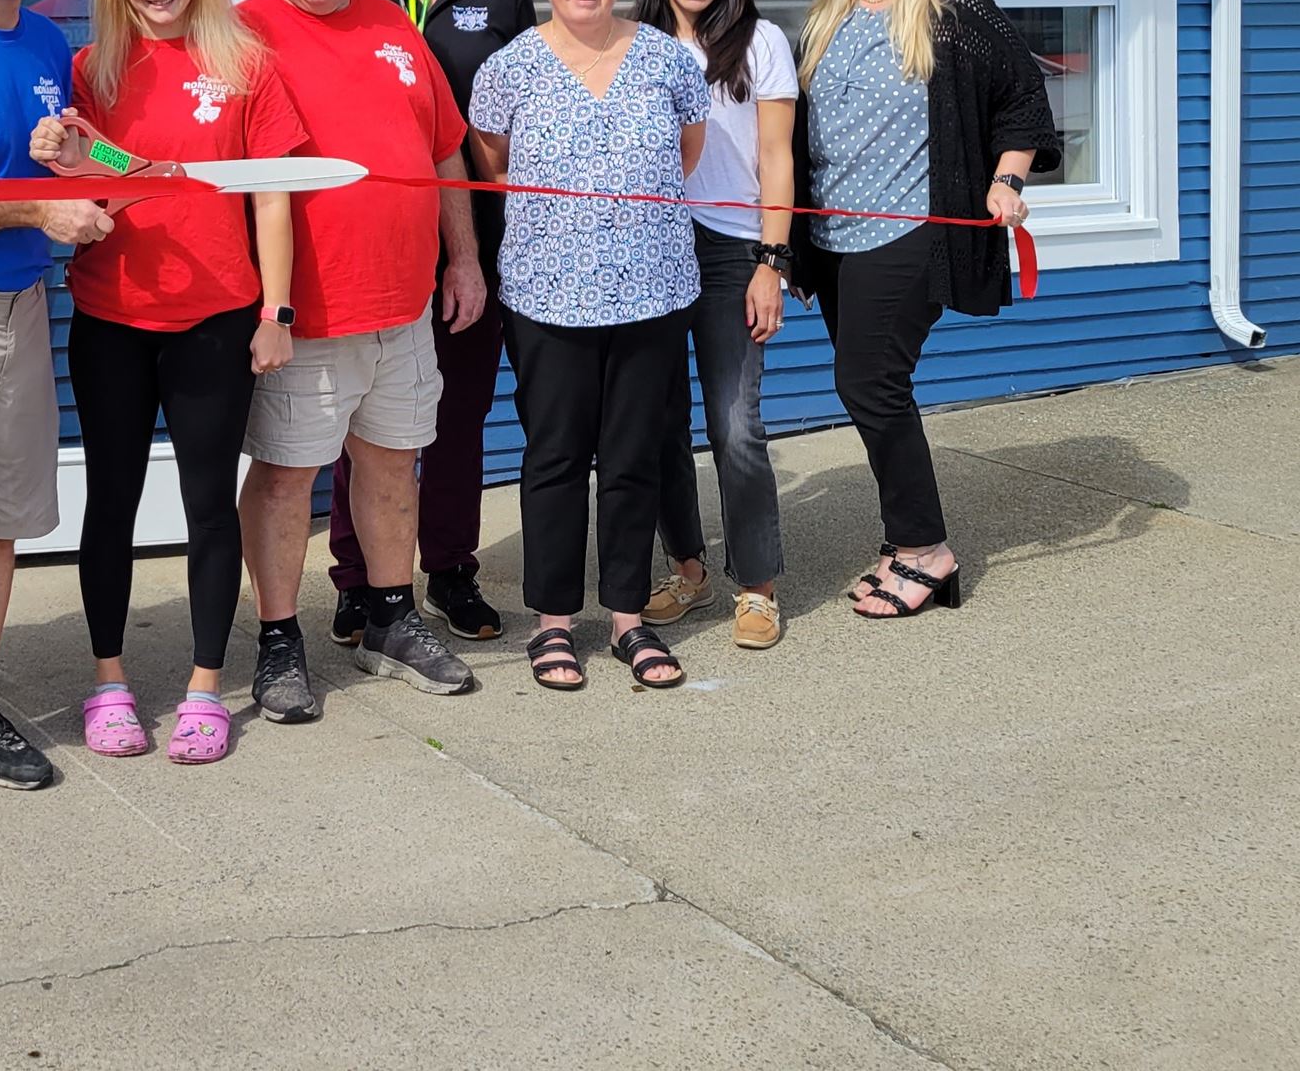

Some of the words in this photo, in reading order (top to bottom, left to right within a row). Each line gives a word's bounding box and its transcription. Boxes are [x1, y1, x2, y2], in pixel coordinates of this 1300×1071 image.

[191, 88, 226, 101] PIZZA
[90, 149, 99, 159] IT
[93, 141, 130, 163] DRACUT
[101, 154, 127, 172] MAKE
